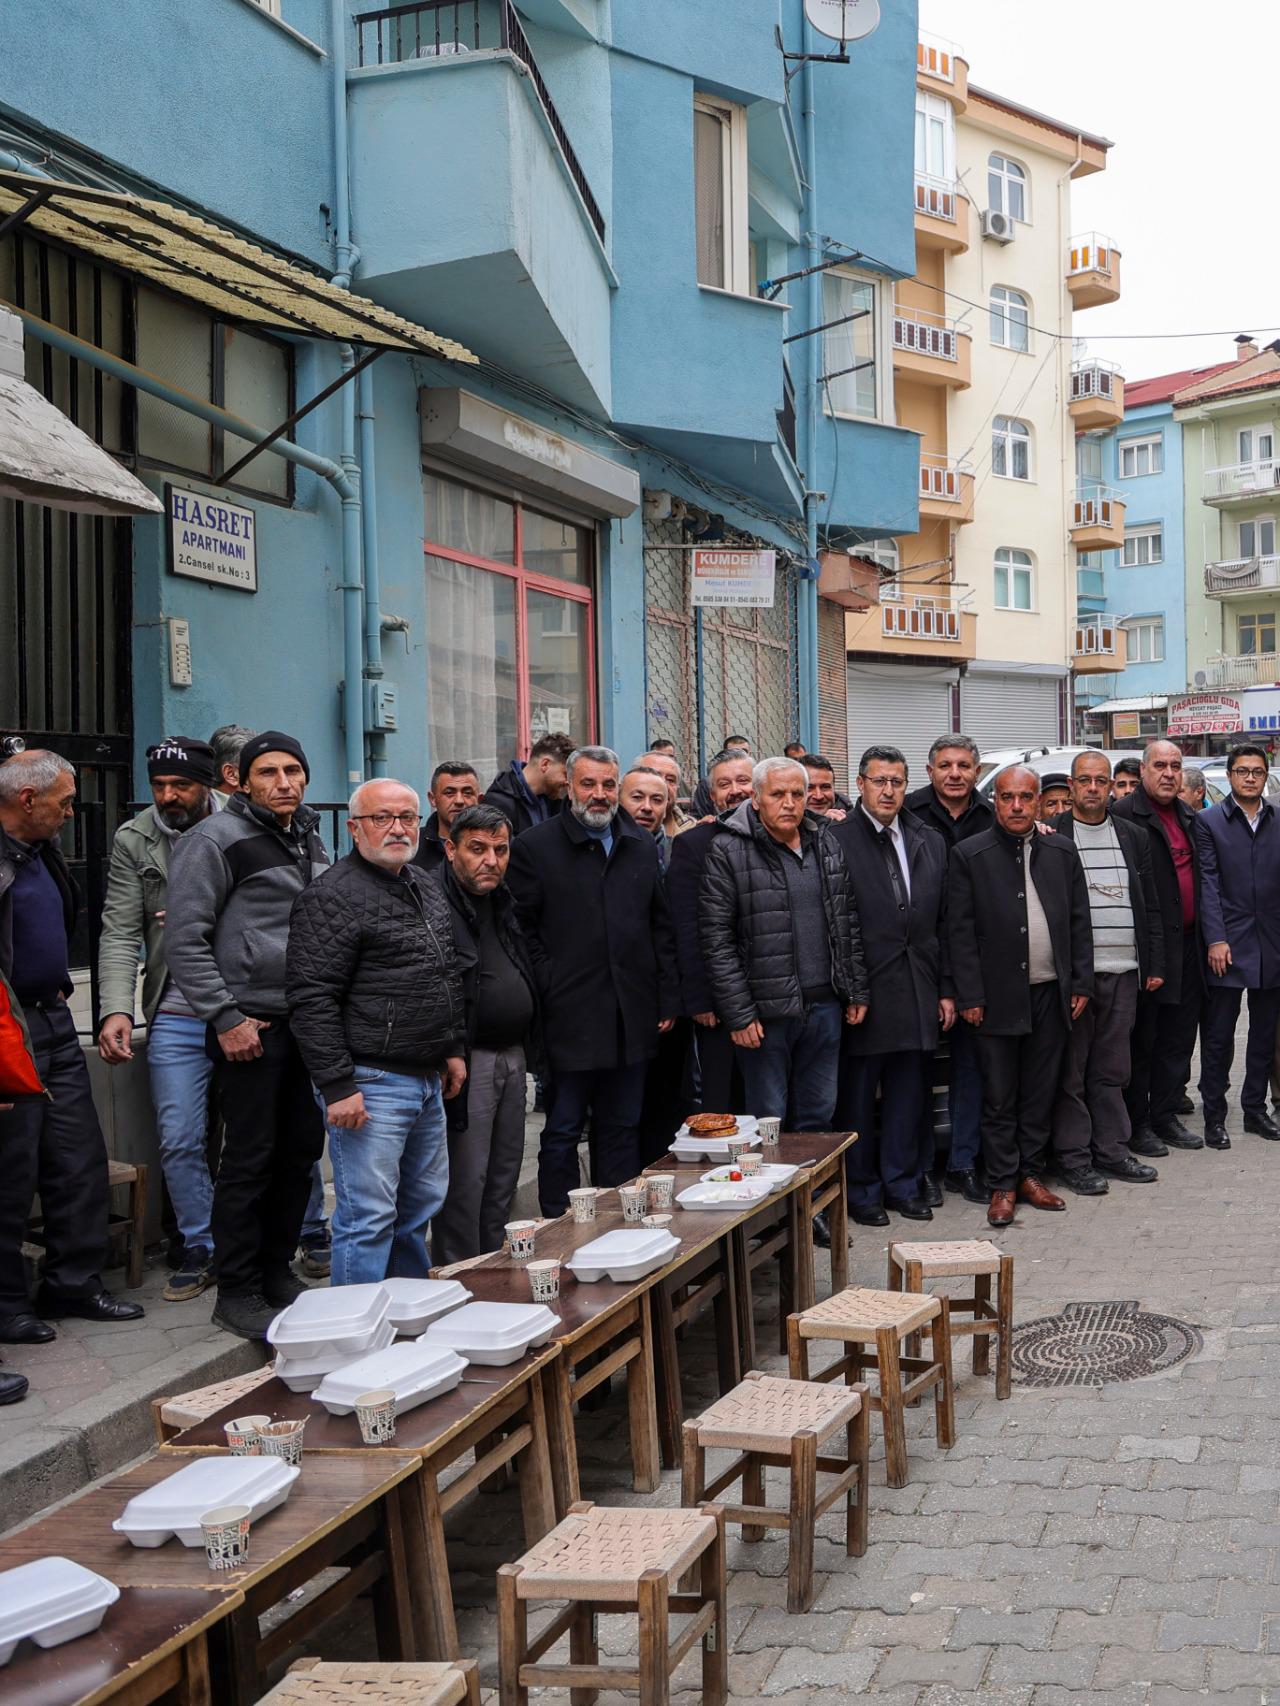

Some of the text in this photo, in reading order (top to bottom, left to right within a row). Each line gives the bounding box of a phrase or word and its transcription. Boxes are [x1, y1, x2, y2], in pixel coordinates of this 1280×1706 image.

[172, 494, 253, 540] HASRET
[182, 530, 246, 561] APARTMANI
[700, 553, 768, 566] KUMDERE
[245, 570, 250, 581] 3
[1171, 694, 1240, 714] PAŞACIOĞLU GIDA
